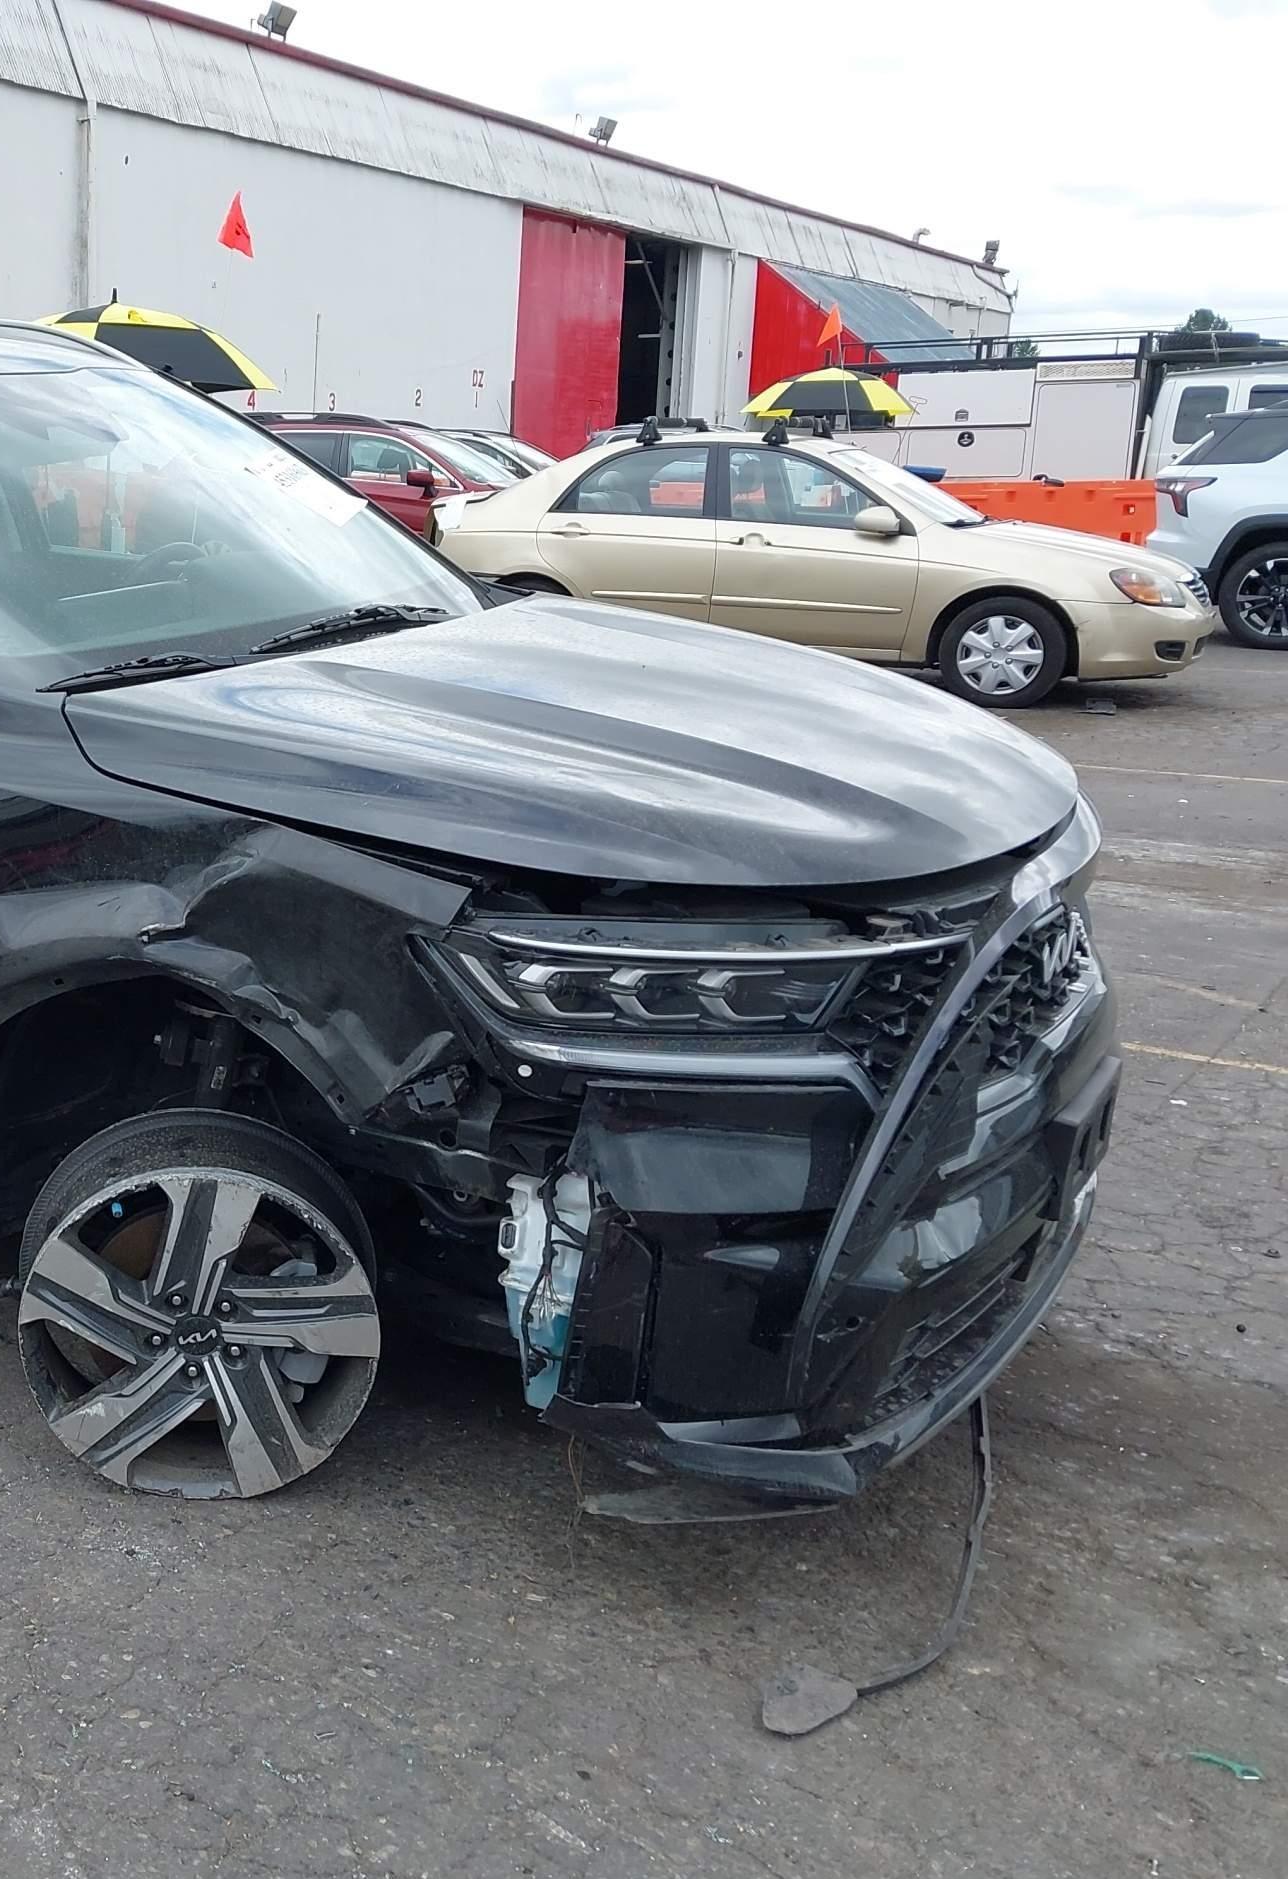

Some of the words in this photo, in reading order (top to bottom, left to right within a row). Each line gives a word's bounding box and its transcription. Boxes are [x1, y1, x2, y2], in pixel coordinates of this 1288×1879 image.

[471, 369, 485, 388] DZ
[247, 390, 256, 411] 4
[328, 392, 336, 412] 3
[414, 389, 422, 407] 2
